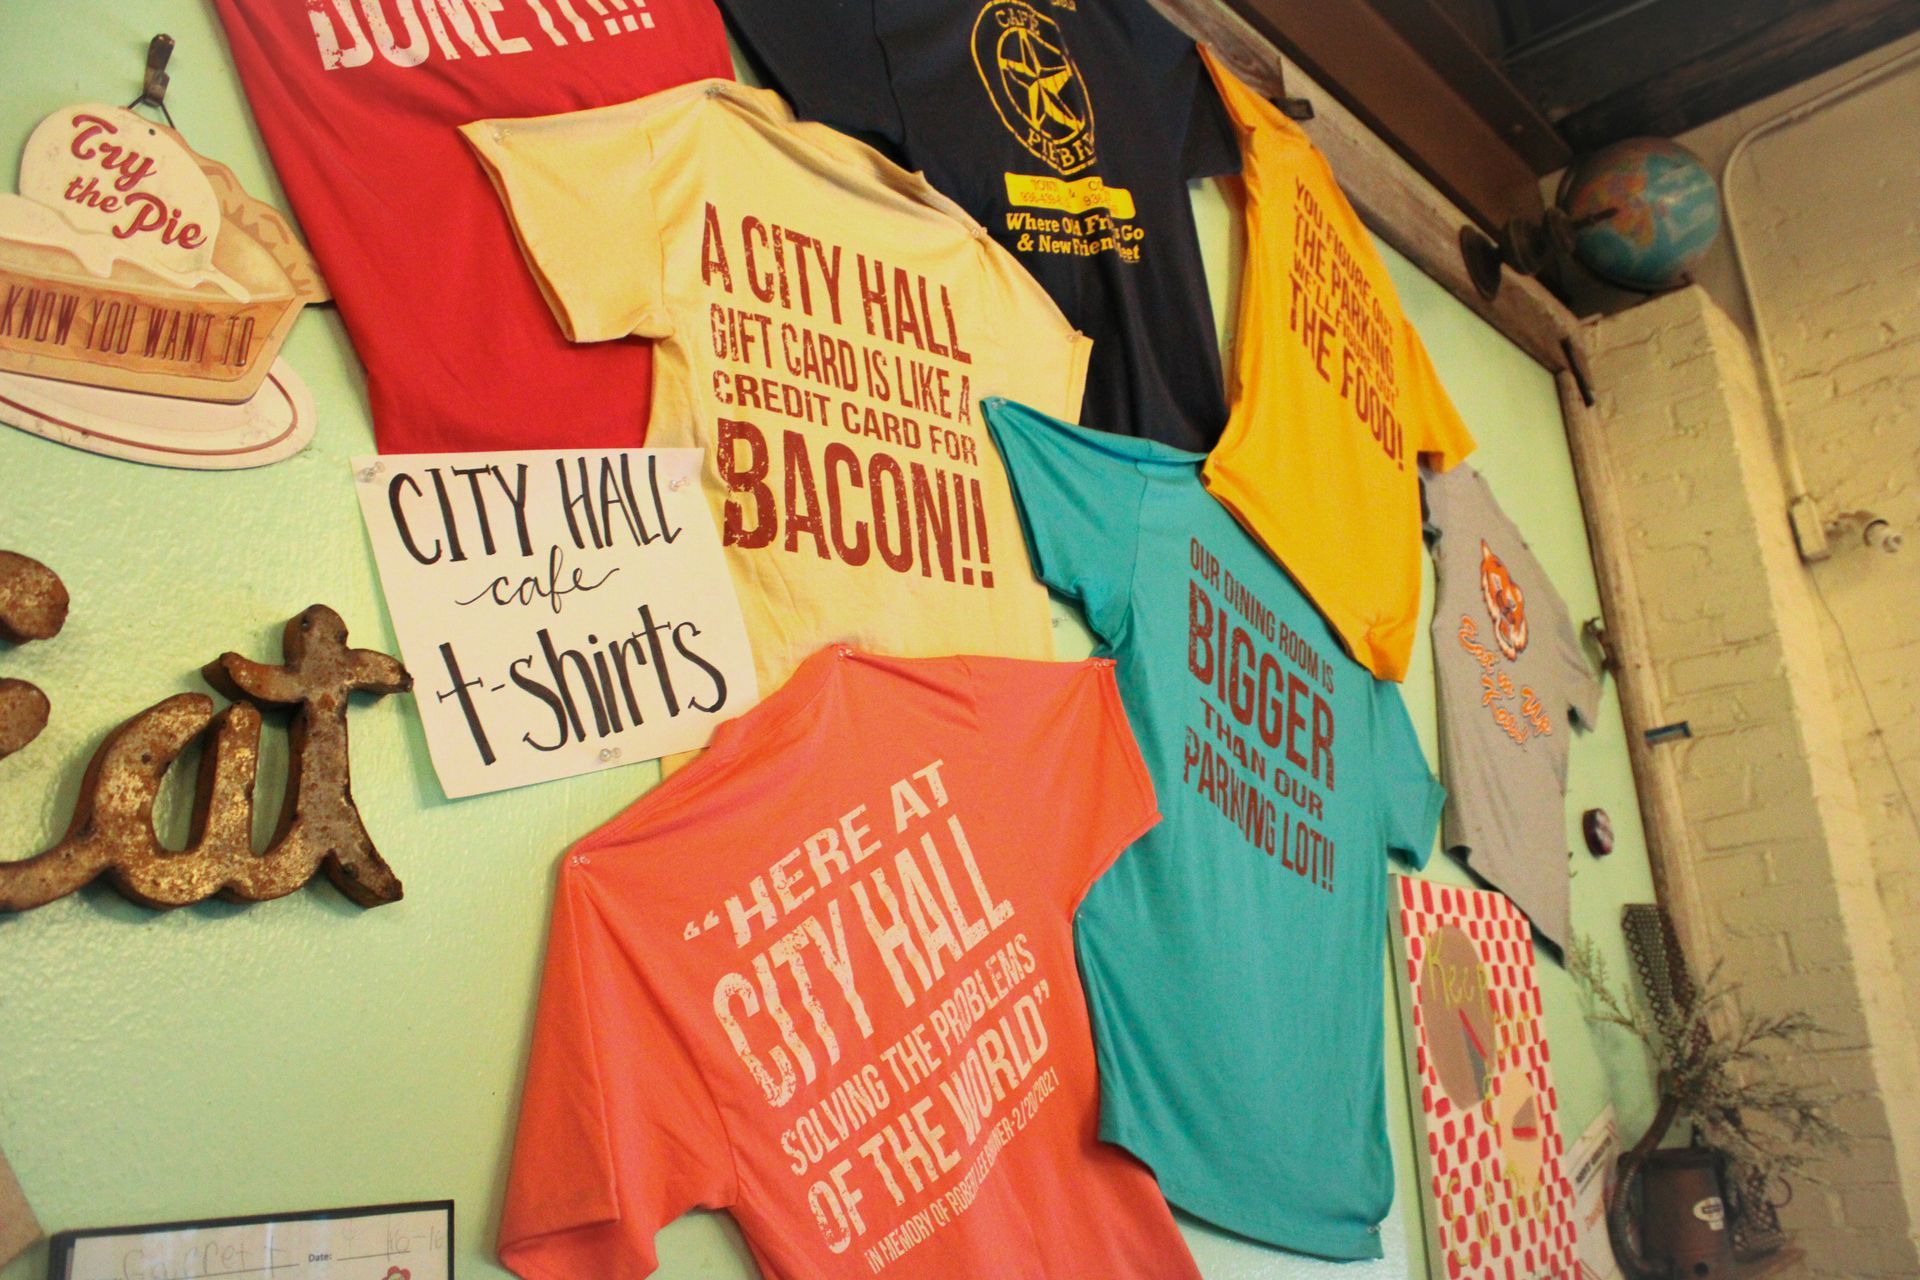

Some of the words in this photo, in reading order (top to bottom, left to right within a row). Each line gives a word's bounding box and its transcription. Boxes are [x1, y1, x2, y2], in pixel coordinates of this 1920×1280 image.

[64, 176, 122, 213] the
[112, 192, 207, 249] Pie
[71, 114, 157, 192] Try
[701, 202, 733, 293] A
[741, 215, 842, 325] CITY
[857, 254, 972, 364] HALL
[1006, 213, 1061, 233] Where
[1121, 225, 1145, 240] Go
[1016, 233, 1034, 252] &
[1039, 234, 1072, 254] New
[1294, 204, 1327, 283] THE
[1295, 176, 1323, 229] YOU
[1327, 223, 1371, 306] FIGURE
[0, 285, 79, 346] KNOW
[87, 297, 137, 354] YOU
[144, 308, 215, 364] WANT
[221, 315, 255, 367] TO
[710, 304, 772, 369] GIFT
[781, 322, 859, 393] CARD
[863, 347, 890, 401] IS
[895, 357, 952, 420] LIKE
[958, 375, 972, 427] A
[1289, 271, 1336, 383] THE
[1340, 346, 1404, 471] FOOD!
[713, 370, 831, 426] CREDIT
[842, 401, 921, 450] CARD
[930, 424, 978, 466] FOR
[389, 464, 534, 565] CITY
[556, 453, 682, 549] HALL
[717, 418, 994, 588] BACON!!
[455, 545, 620, 614] cafe
[1190, 537, 1220, 591] OUR
[1225, 569, 1276, 643] DINING
[1280, 621, 1319, 682] ROOM
[1322, 660, 1335, 694] IS
[436, 605, 728, 765] t-shirts
[1188, 578, 1334, 791] BIGGER
[890, 759, 952, 834] AT
[1184, 726, 1276, 856] PARKING
[1282, 811, 1334, 893] LOT!!
[1200, 697, 1266, 781] THAN
[1275, 768, 1323, 821] OUR
[713, 899, 874, 1108] CITY
[851, 815, 1016, 1009] HALL
[781, 1064, 891, 1177] SOLVING
[880, 1023, 942, 1094] THE
[930, 933, 1036, 1059] PROBLEMS
[808, 1159, 870, 1255] OF
[858, 1096, 963, 1206] THE
[864, 1246, 886, 1275] IN
[878, 1208, 935, 1264] MEMORY
[929, 1197, 950, 1228] OF
[976, 1151, 989, 1185] LEE
[308, 1253, 333, 1262] Date:
